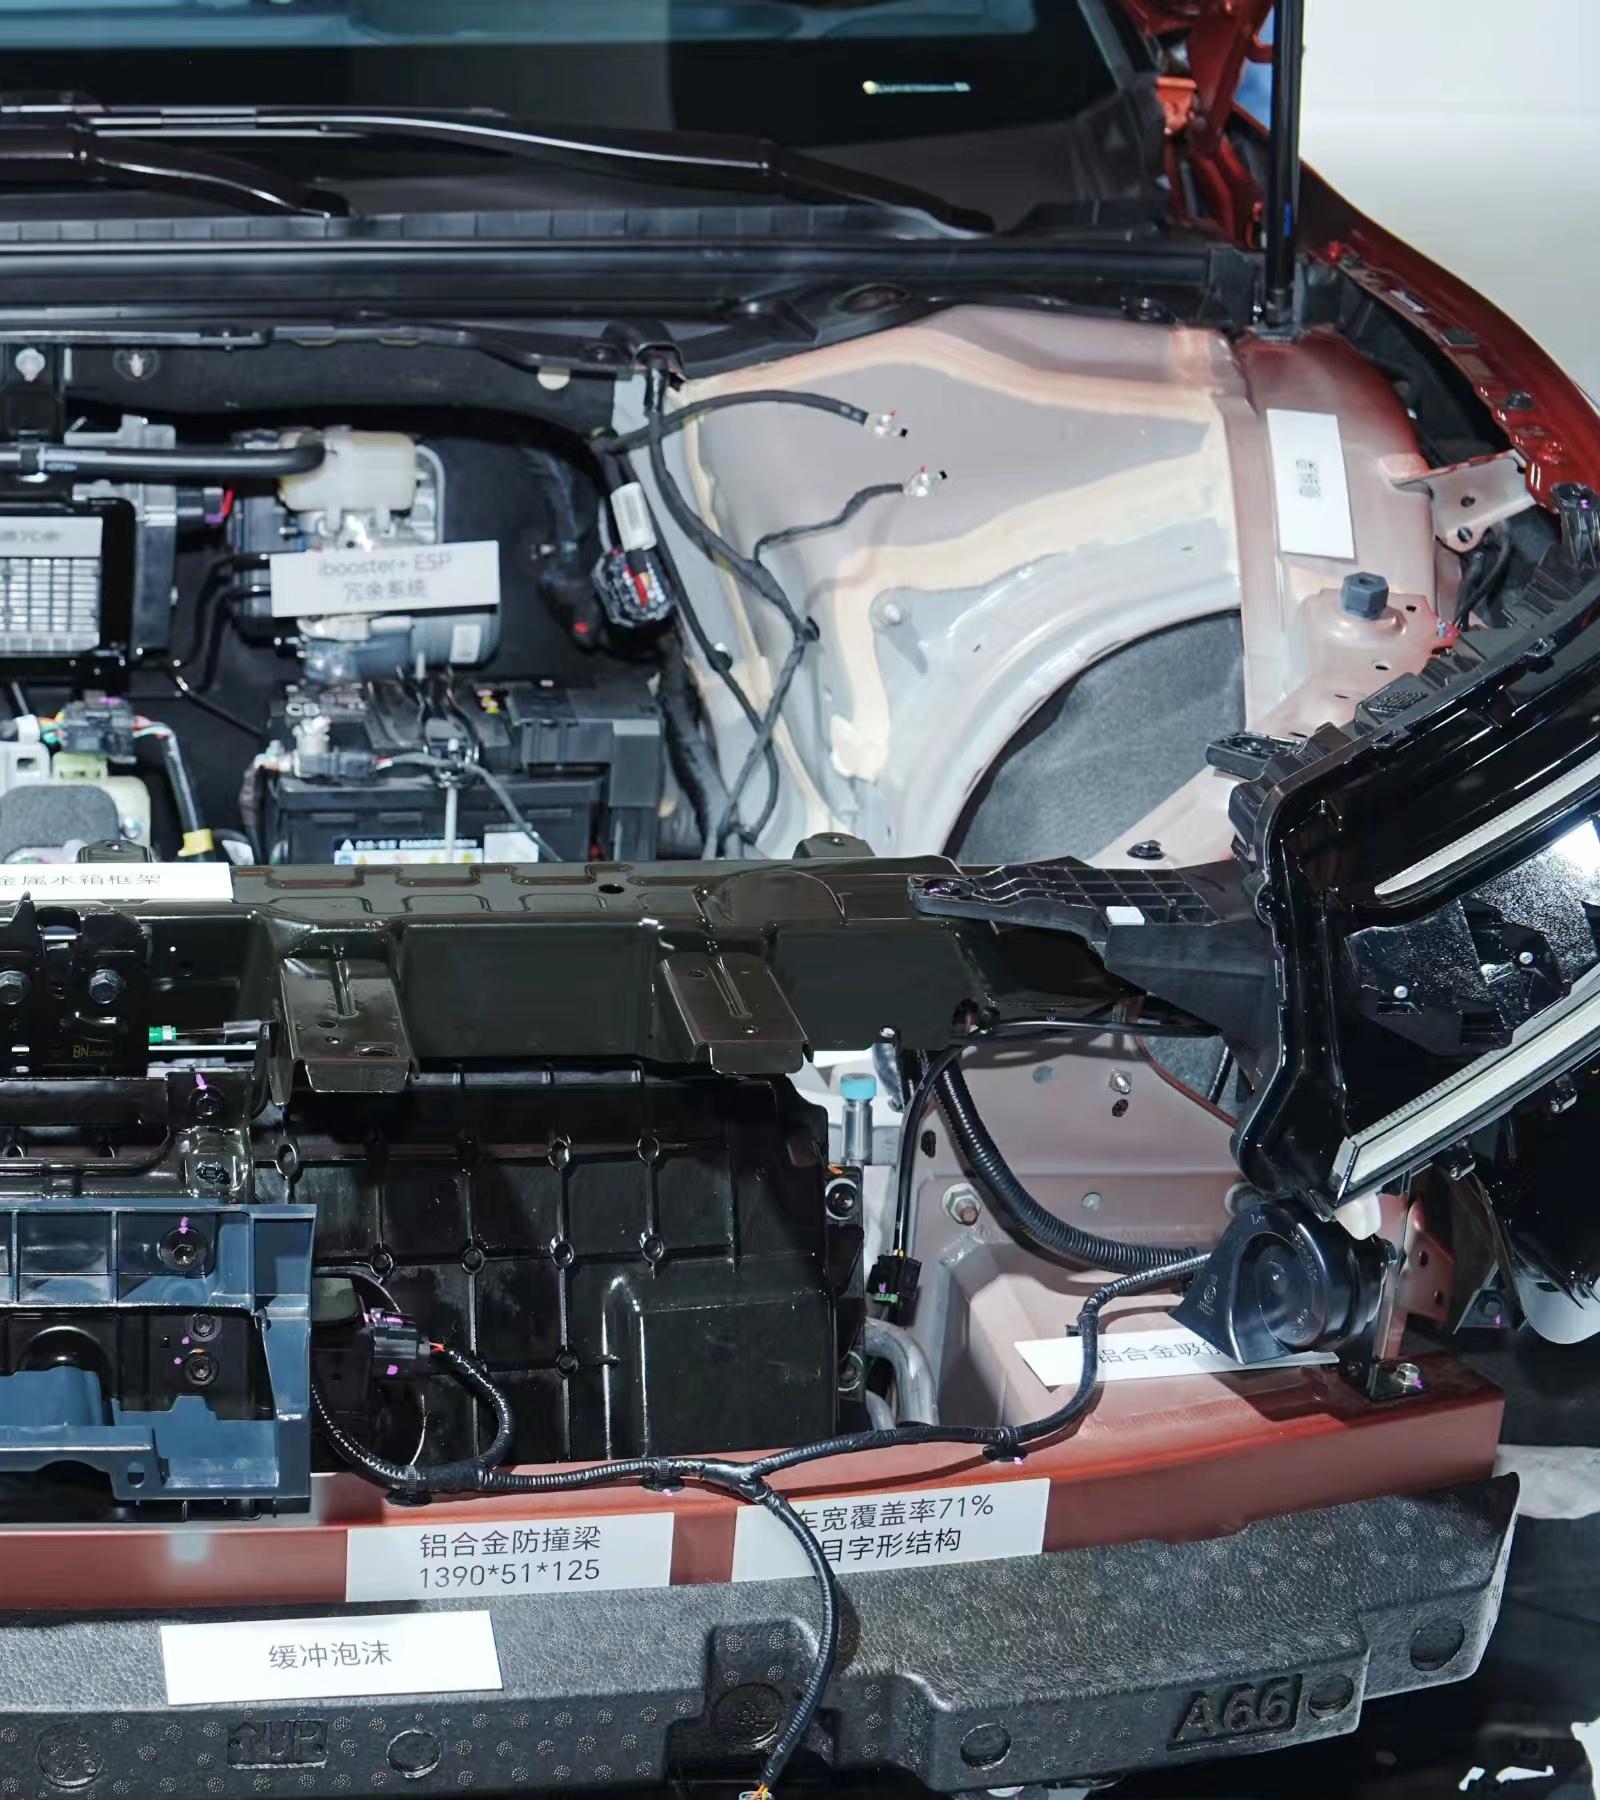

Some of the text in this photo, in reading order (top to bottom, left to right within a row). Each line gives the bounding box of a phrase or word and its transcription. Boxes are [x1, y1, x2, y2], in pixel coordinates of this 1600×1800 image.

[414, 552, 452, 572] ESP
[419, 1526, 601, 1559] 铝合金防撞梁
[821, 1527, 961, 1563] 目字形结构
[268, 1639, 392, 1670] 缓冲泡沫
[1173, 1675, 1293, 1742] A66
